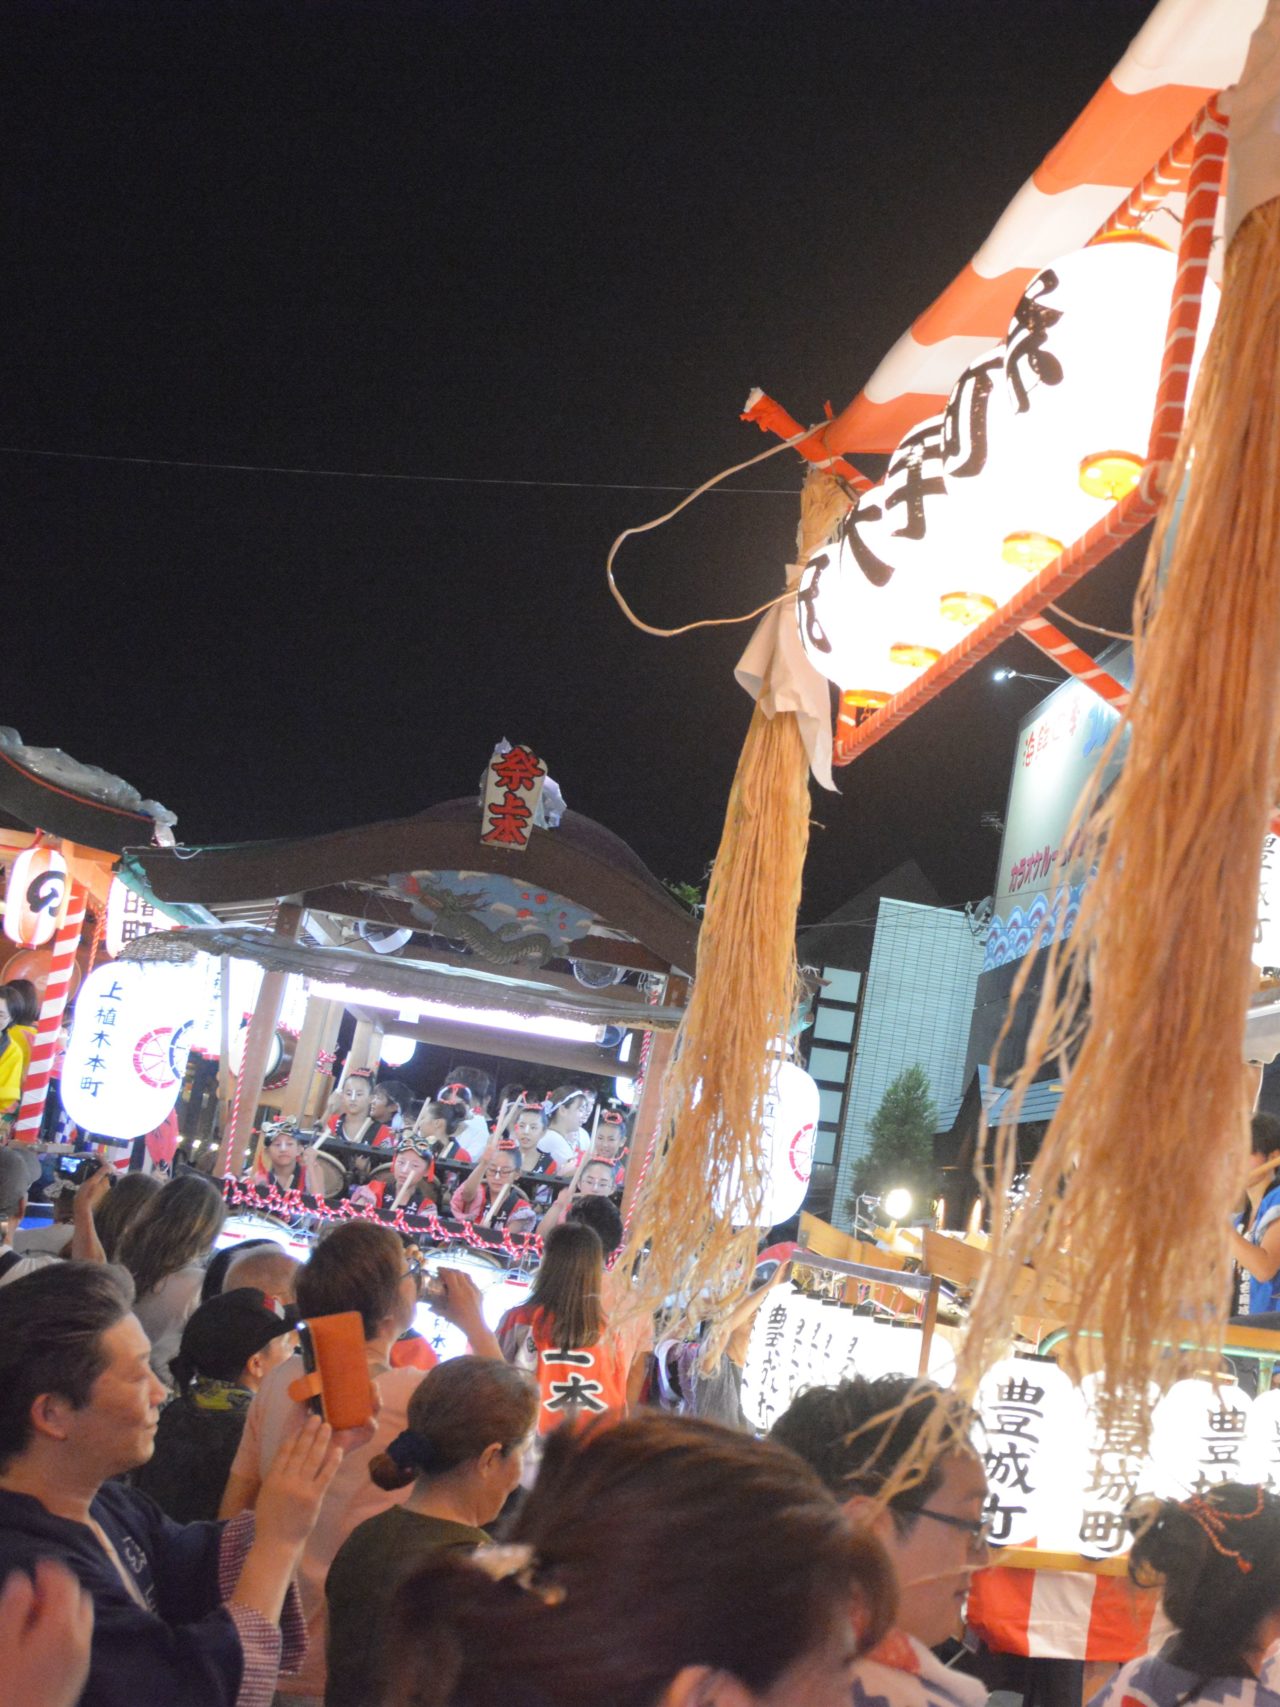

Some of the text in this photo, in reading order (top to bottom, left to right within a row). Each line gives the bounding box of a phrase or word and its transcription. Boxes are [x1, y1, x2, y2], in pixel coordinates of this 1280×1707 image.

[481, 746, 545, 845] 祭上本
[81, 982, 122, 1097] 上植木本町
